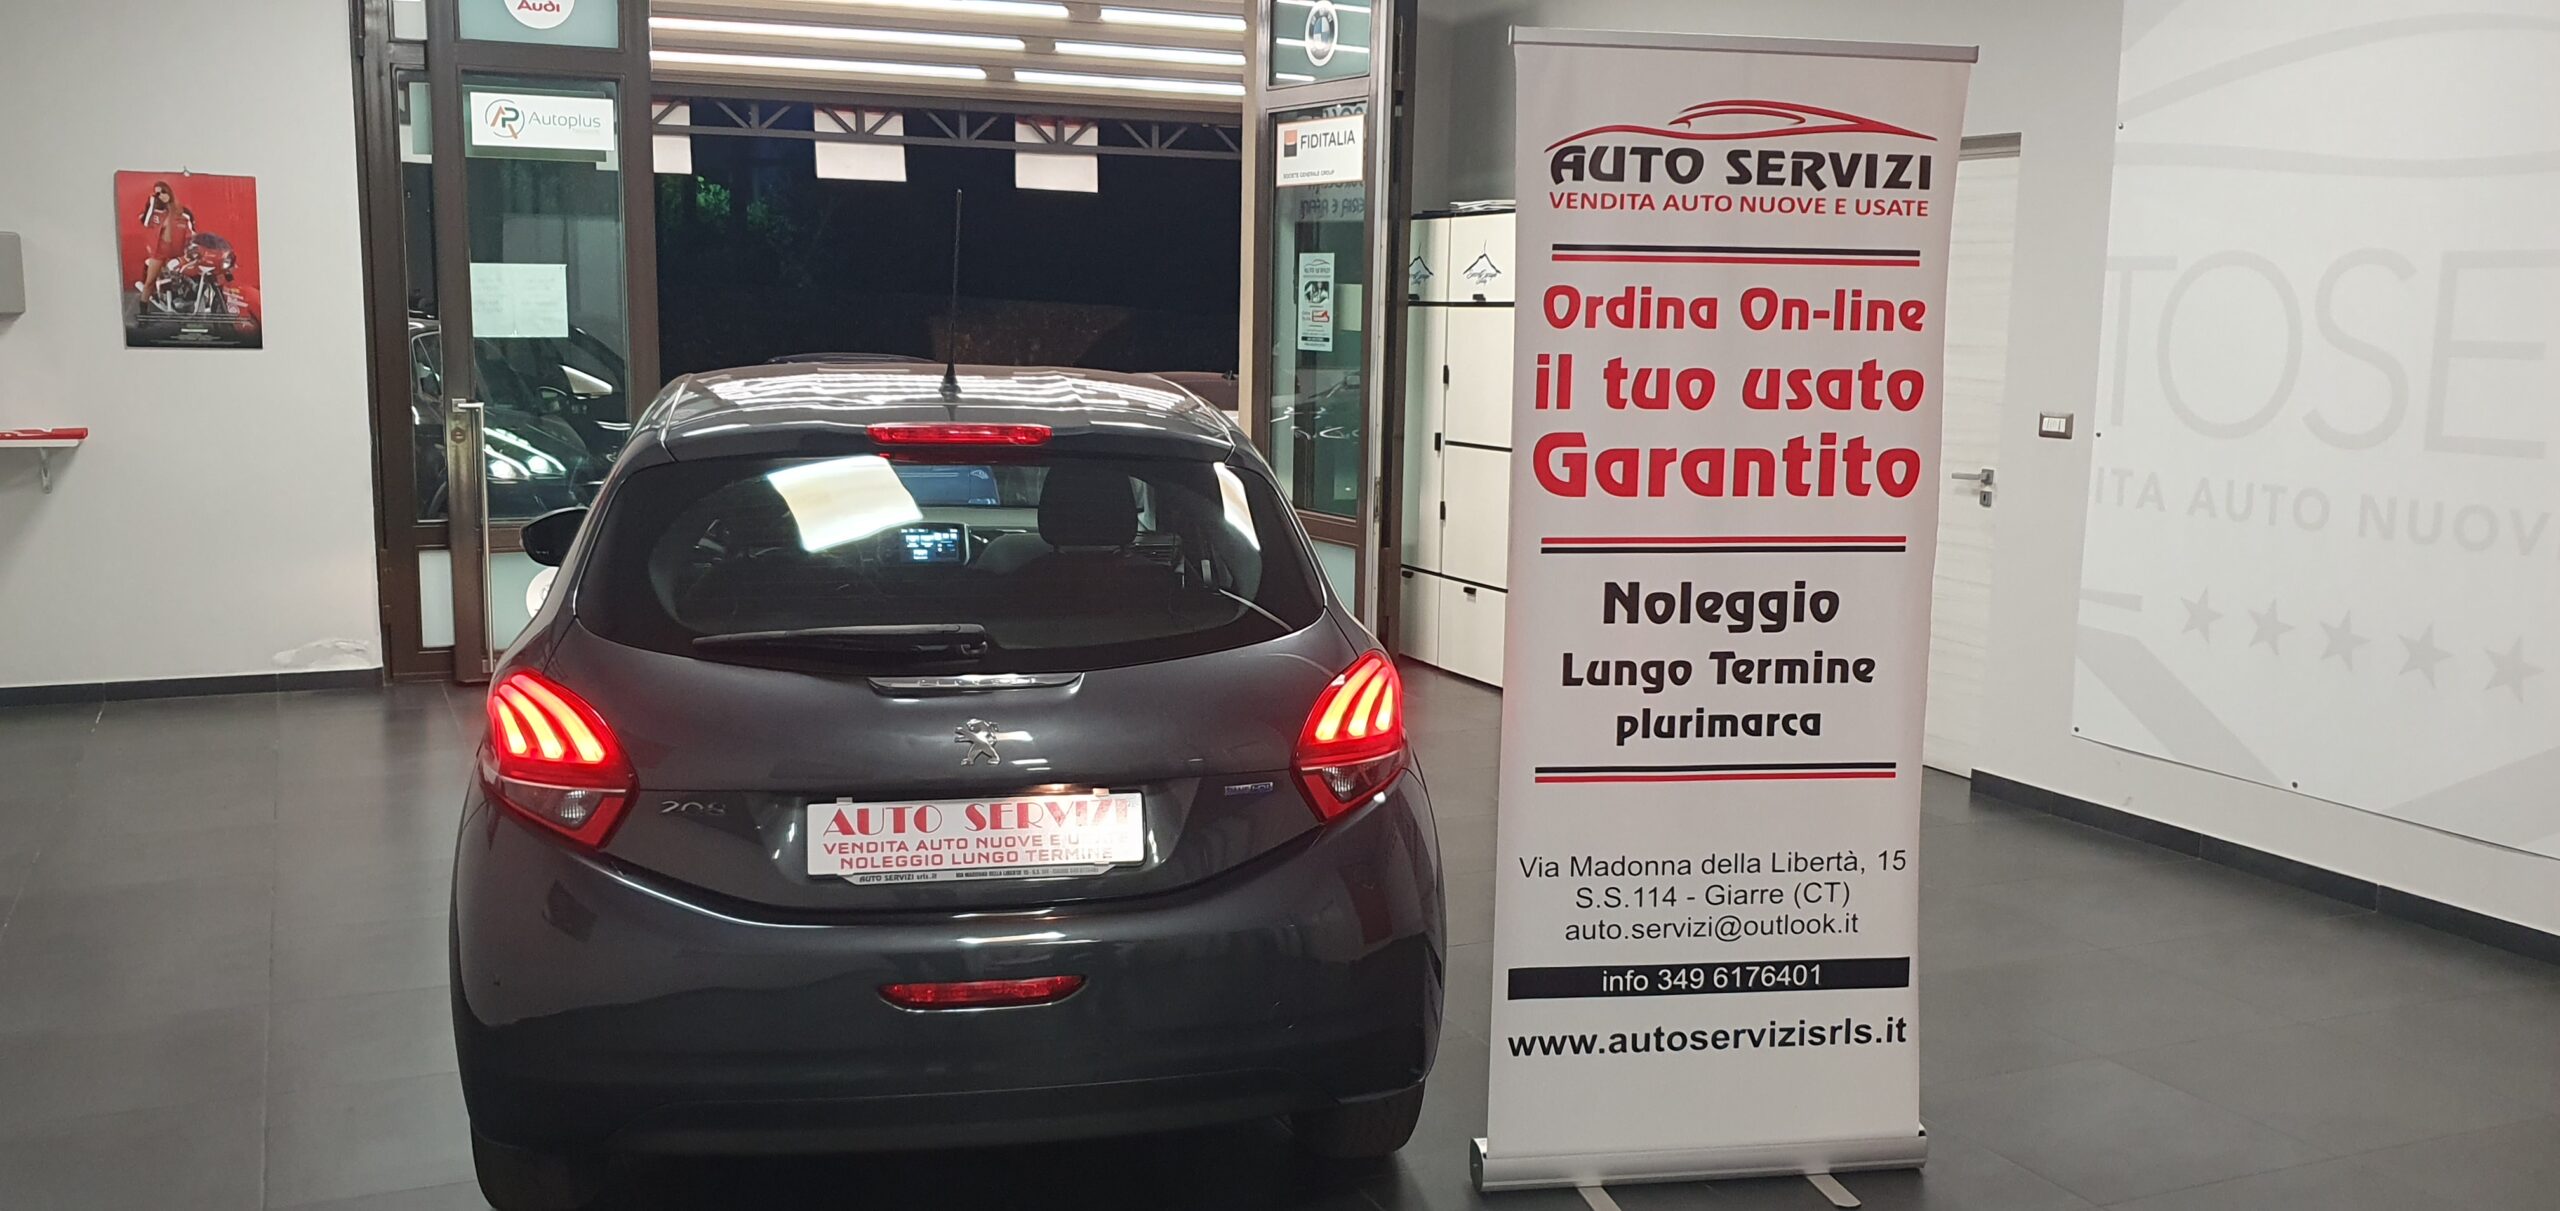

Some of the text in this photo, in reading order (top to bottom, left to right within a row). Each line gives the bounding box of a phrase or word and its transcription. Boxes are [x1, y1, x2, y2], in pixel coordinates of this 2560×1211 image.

[517, 0, 560, 12] Audi
[528, 111, 601, 130] Autoplus
[1300, 130, 1356, 150] FIDITALIA
[1550, 145, 1932, 192] AUTO SERVIZI
[1550, 191, 1929, 217] VENDITA AUTO NUOVE E USATE
[1543, 284, 1926, 332] Ordina On-line
[1535, 353, 1925, 411] il tuo usato
[1532, 431, 1921, 498] Garantito
[2187, 477, 2331, 532] AUTO
[1603, 580, 1840, 633] Noleggio
[1562, 650, 1876, 694] Lungo Termine
[1616, 707, 1821, 746] plurimarca
[823, 799, 1129, 837] AUTO SERVIZI
[824, 840, 909, 855] VENDITA
[916, 837, 968, 851] AUTO
[976, 834, 1043, 850] NUOVE
[1050, 834, 1061, 846] E
[841, 847, 1113, 870] NOLEGGIO LUNGO TERMINE
[885, 873, 914, 881] SERVIZI
[1519, 849, 1907, 878] Via Madonna della Libertà, 15
[1575, 886, 1677, 909] S.S.114
[1705, 883, 1785, 907] Giarre
[1793, 880, 1851, 909] (CT)
[1565, 914, 1860, 943] auto.servizi@outlook.it
[1602, 963, 1823, 993] info 349 6176401
[1508, 1017, 1907, 1058] www.autoservizisrls.it
